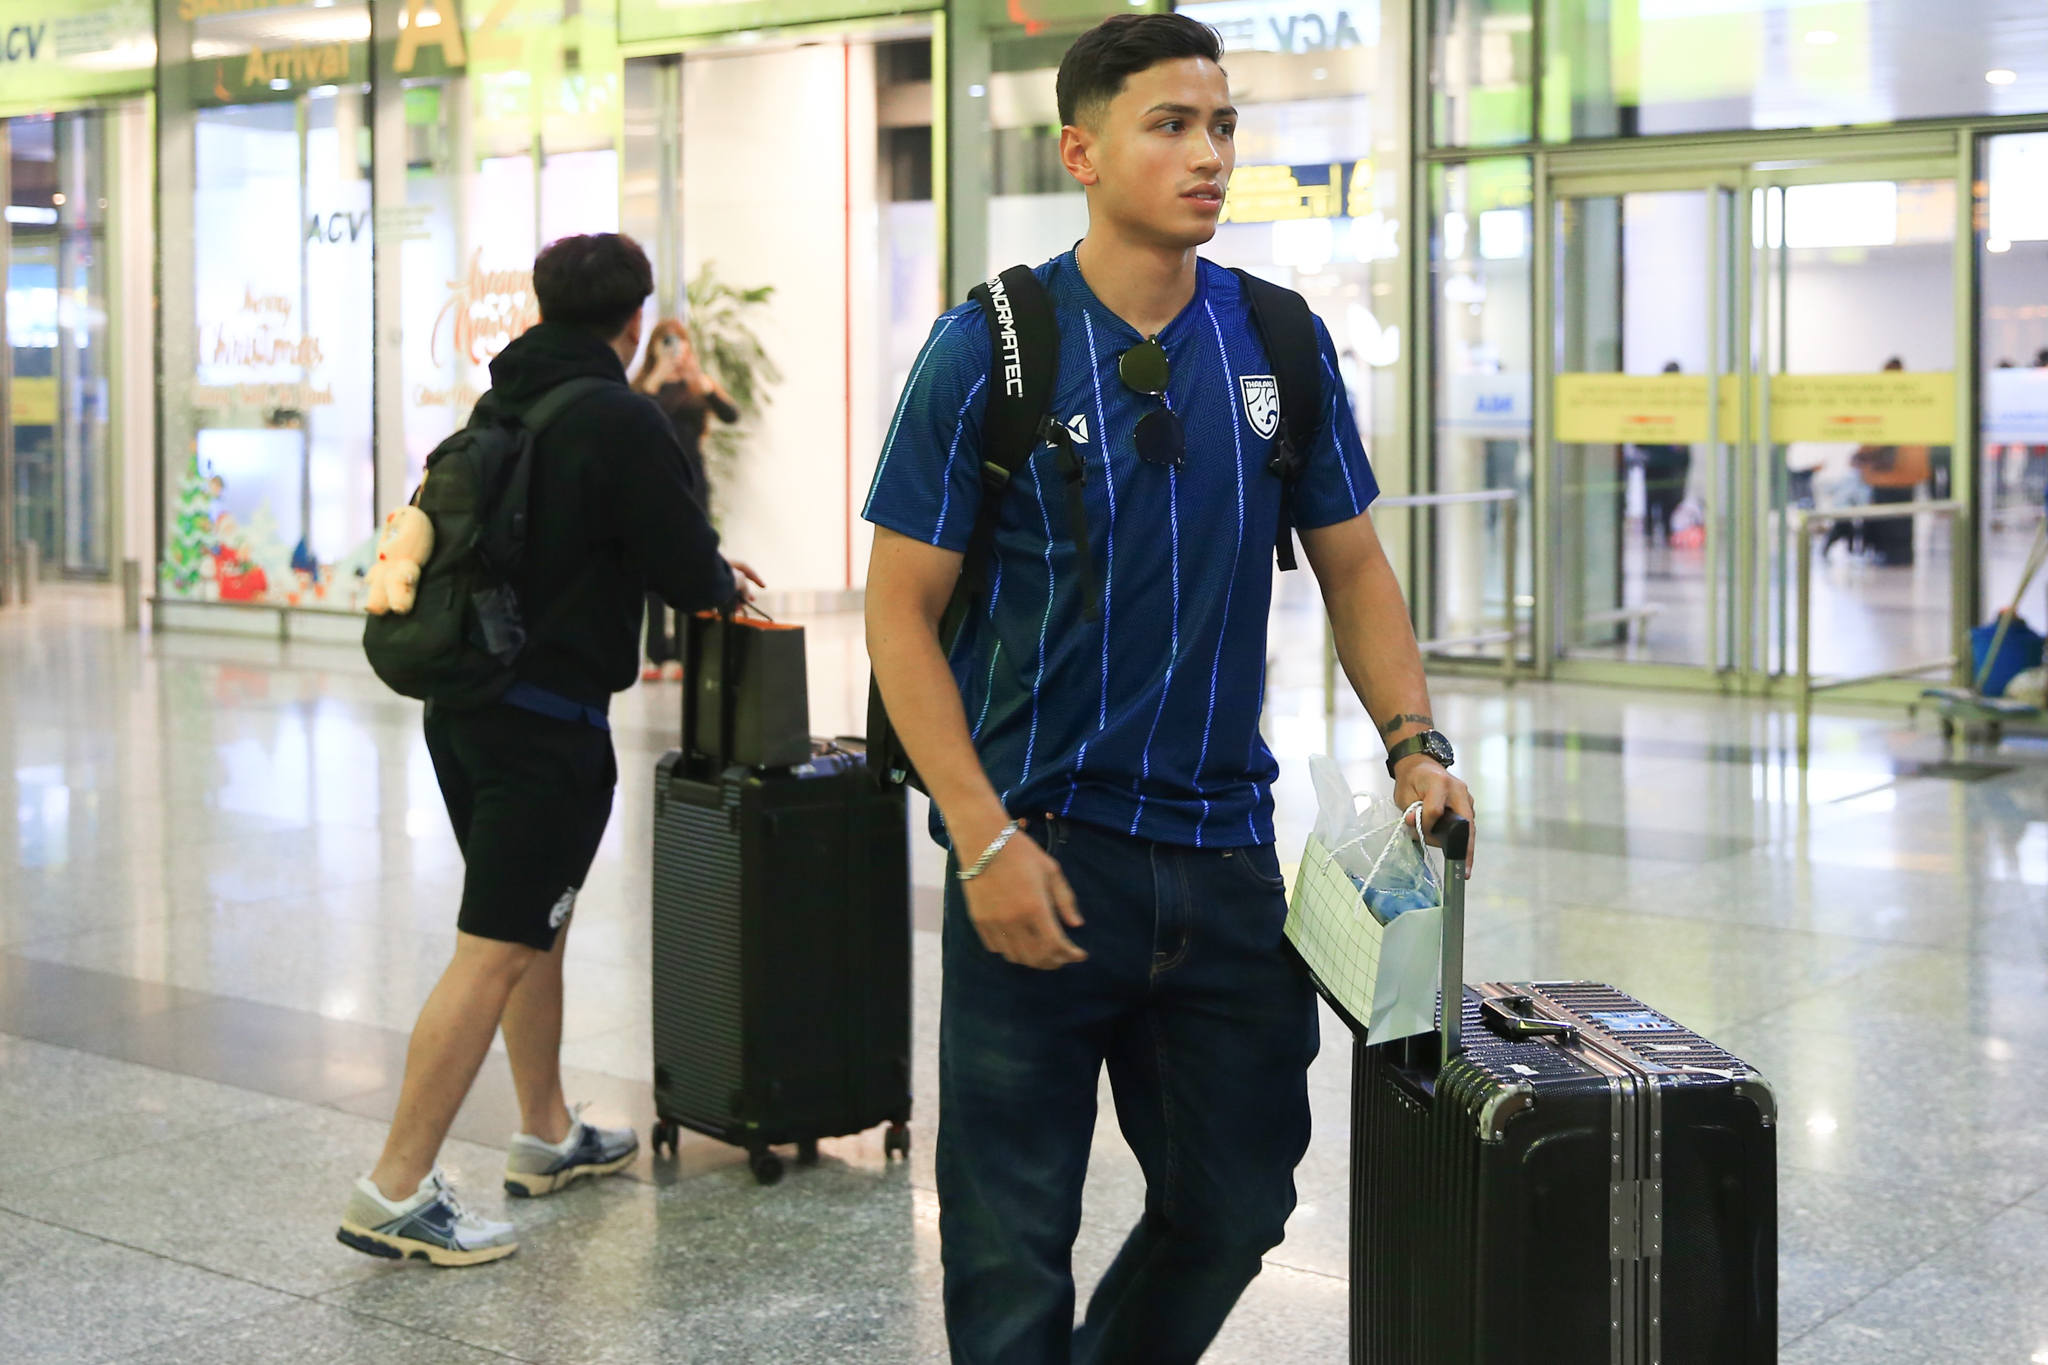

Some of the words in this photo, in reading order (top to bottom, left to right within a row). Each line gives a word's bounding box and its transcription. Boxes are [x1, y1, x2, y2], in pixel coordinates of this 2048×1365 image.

[0, 24, 45, 61] CV
[243, 42, 349, 86] Arrival
[307, 210, 370, 243] ACV
[989, 282, 1022, 397] NORMATEC
